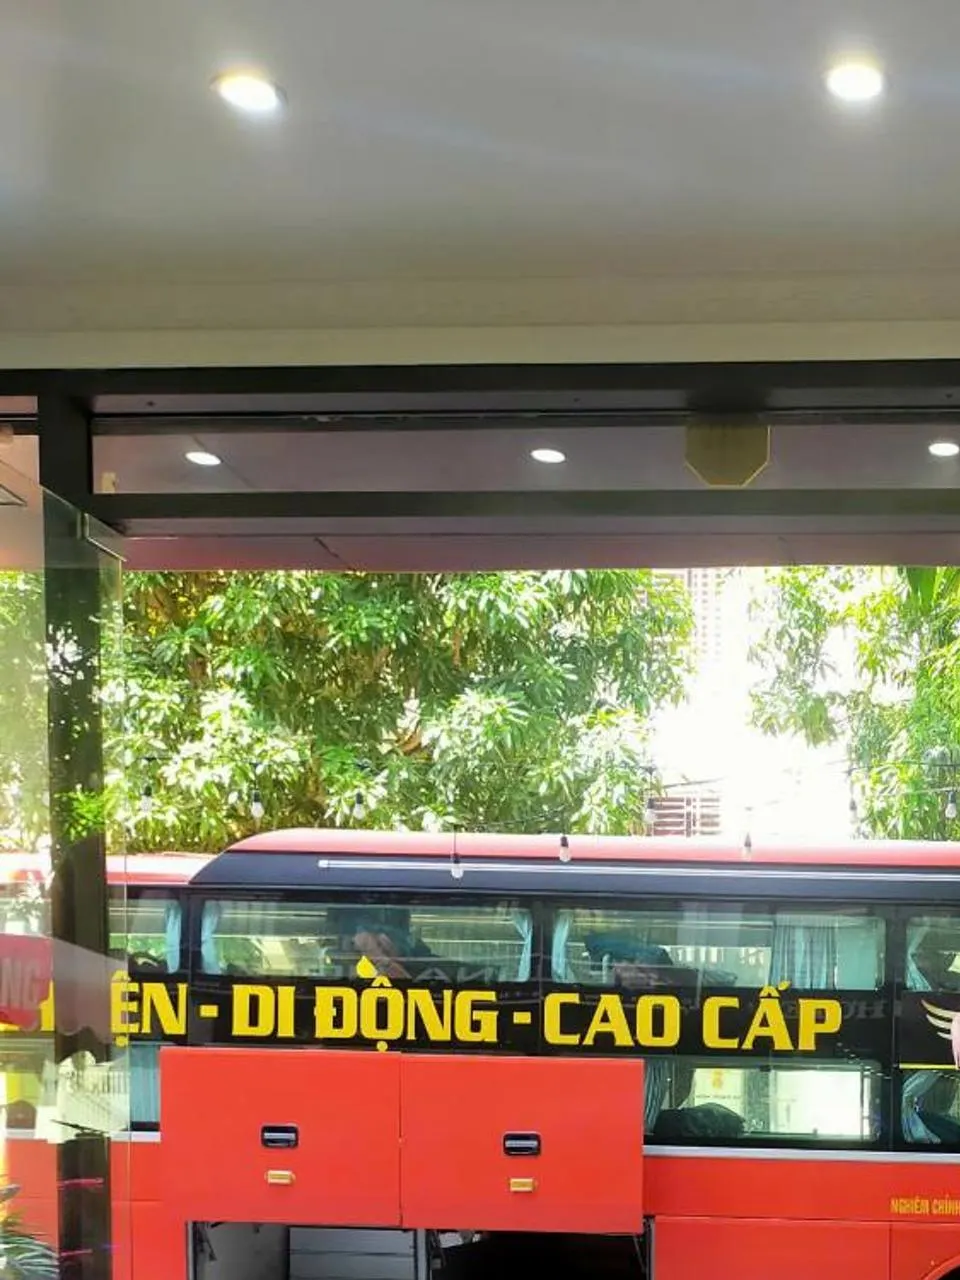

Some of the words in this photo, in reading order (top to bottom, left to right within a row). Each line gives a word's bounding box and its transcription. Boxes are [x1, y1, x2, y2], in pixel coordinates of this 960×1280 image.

[231, 984, 296, 1037] DI
[314, 975, 499, 1051] ĐỘNG
[543, 992, 681, 1047] CAO
[702, 981, 842, 1051] CẤP
